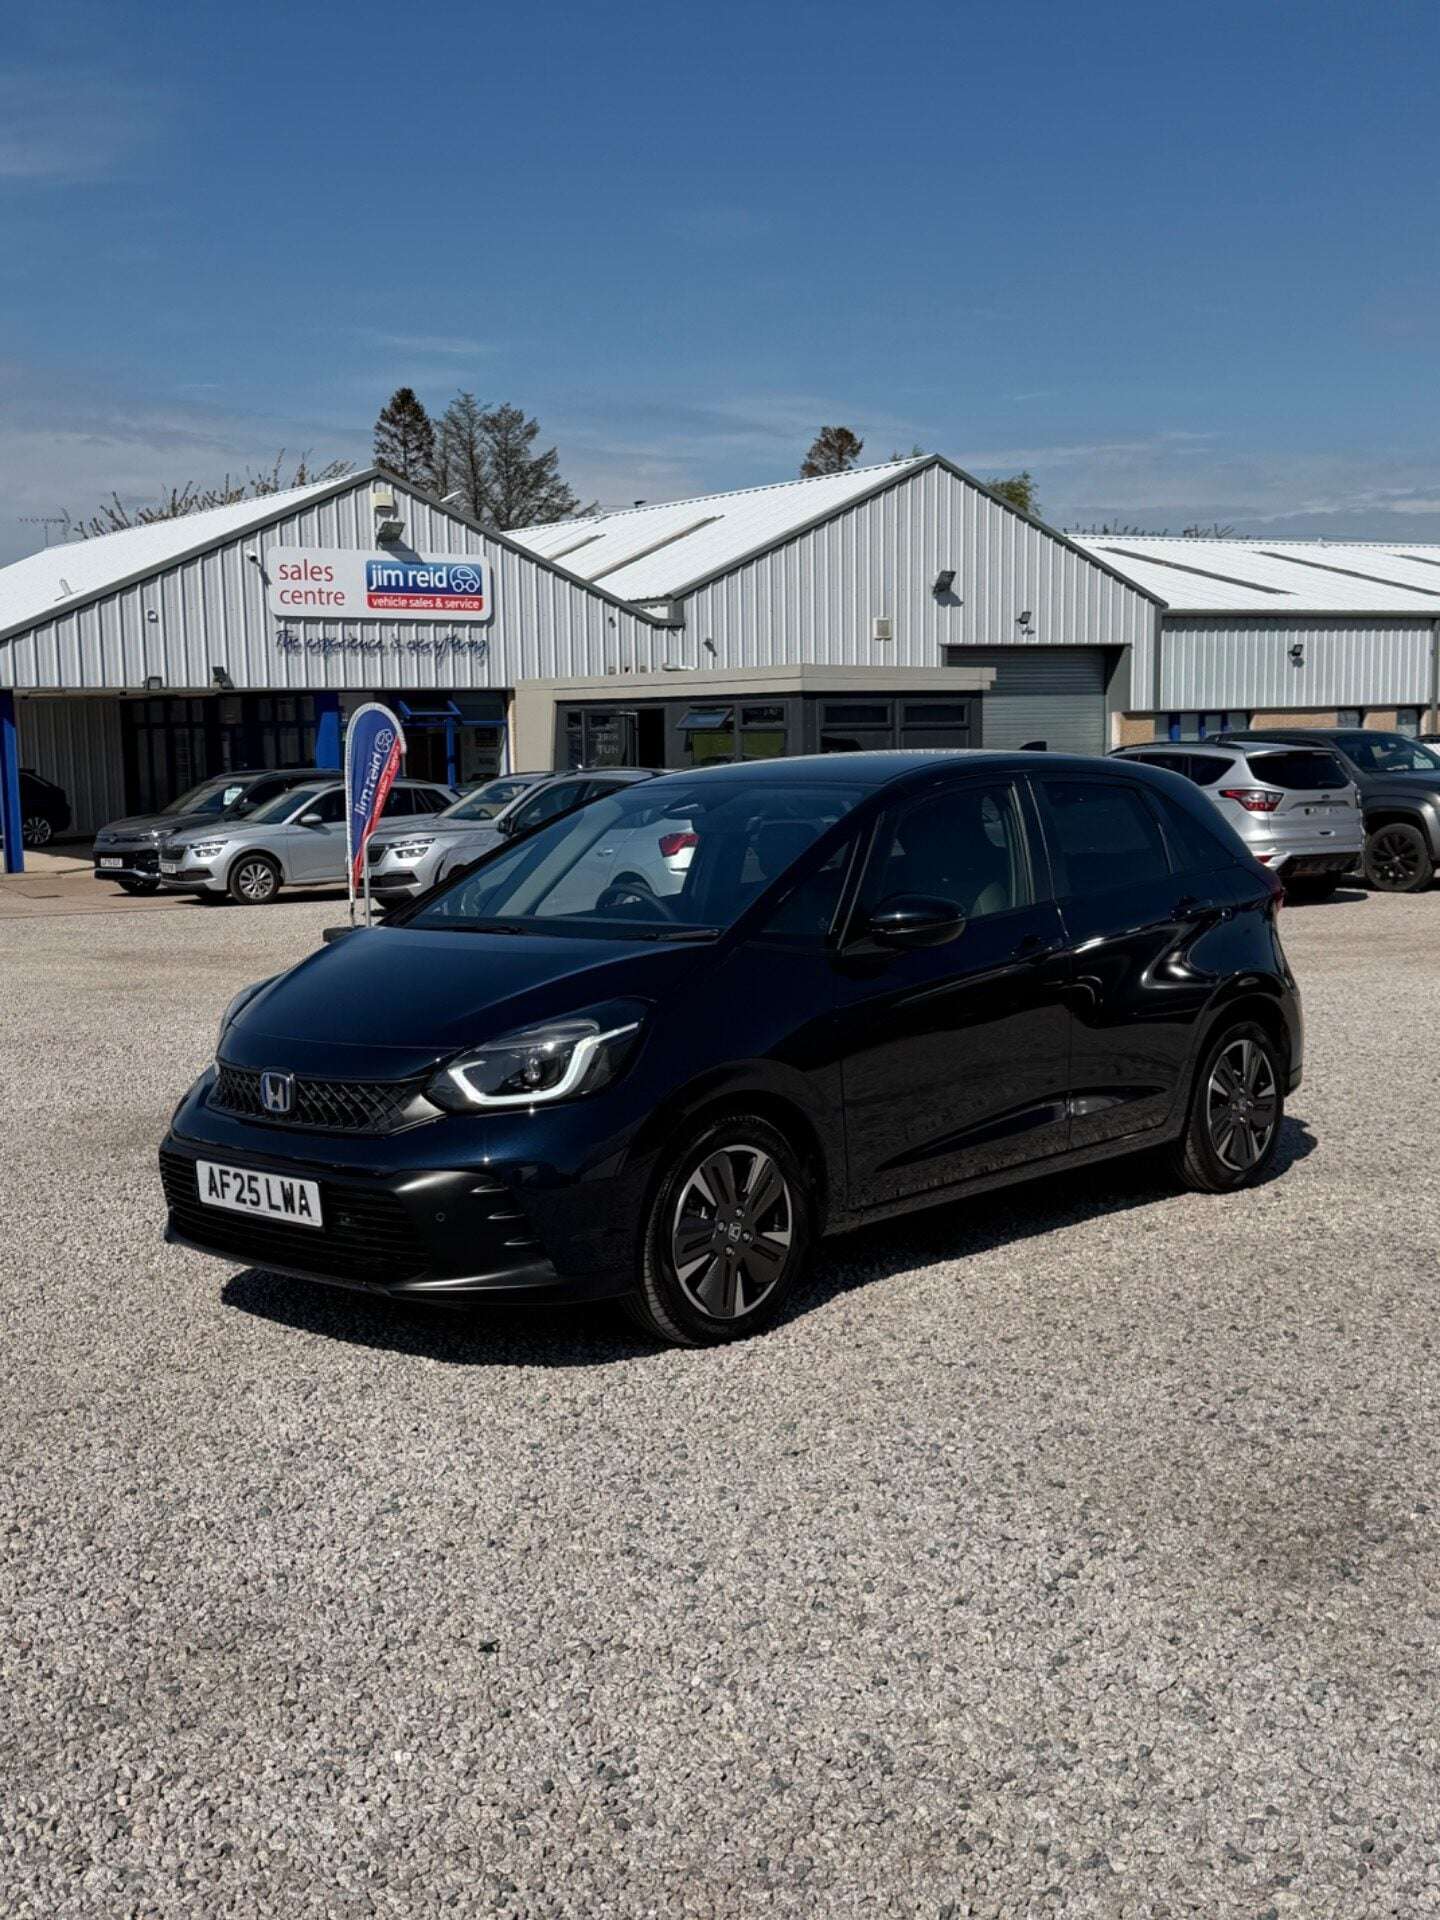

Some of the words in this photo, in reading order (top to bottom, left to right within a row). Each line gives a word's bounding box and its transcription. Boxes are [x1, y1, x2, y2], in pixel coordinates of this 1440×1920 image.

[279, 559, 333, 582] sales
[369, 564, 404, 590] jim
[408, 566, 447, 588] reid
[280, 587, 345, 606] centre
[371, 597, 408, 607] vehicle
[409, 599, 434, 608] sales
[435, 598, 443, 608] &
[444, 599, 480, 610] service
[276, 630, 301, 650] The
[304, 634, 385, 659] experience
[406, 635, 488, 668] everything
[354, 788, 373, 818] jim
[366, 752, 382, 788] reid
[208, 1165, 261, 1207] AF25
[265, 1178, 312, 1218] LWA
